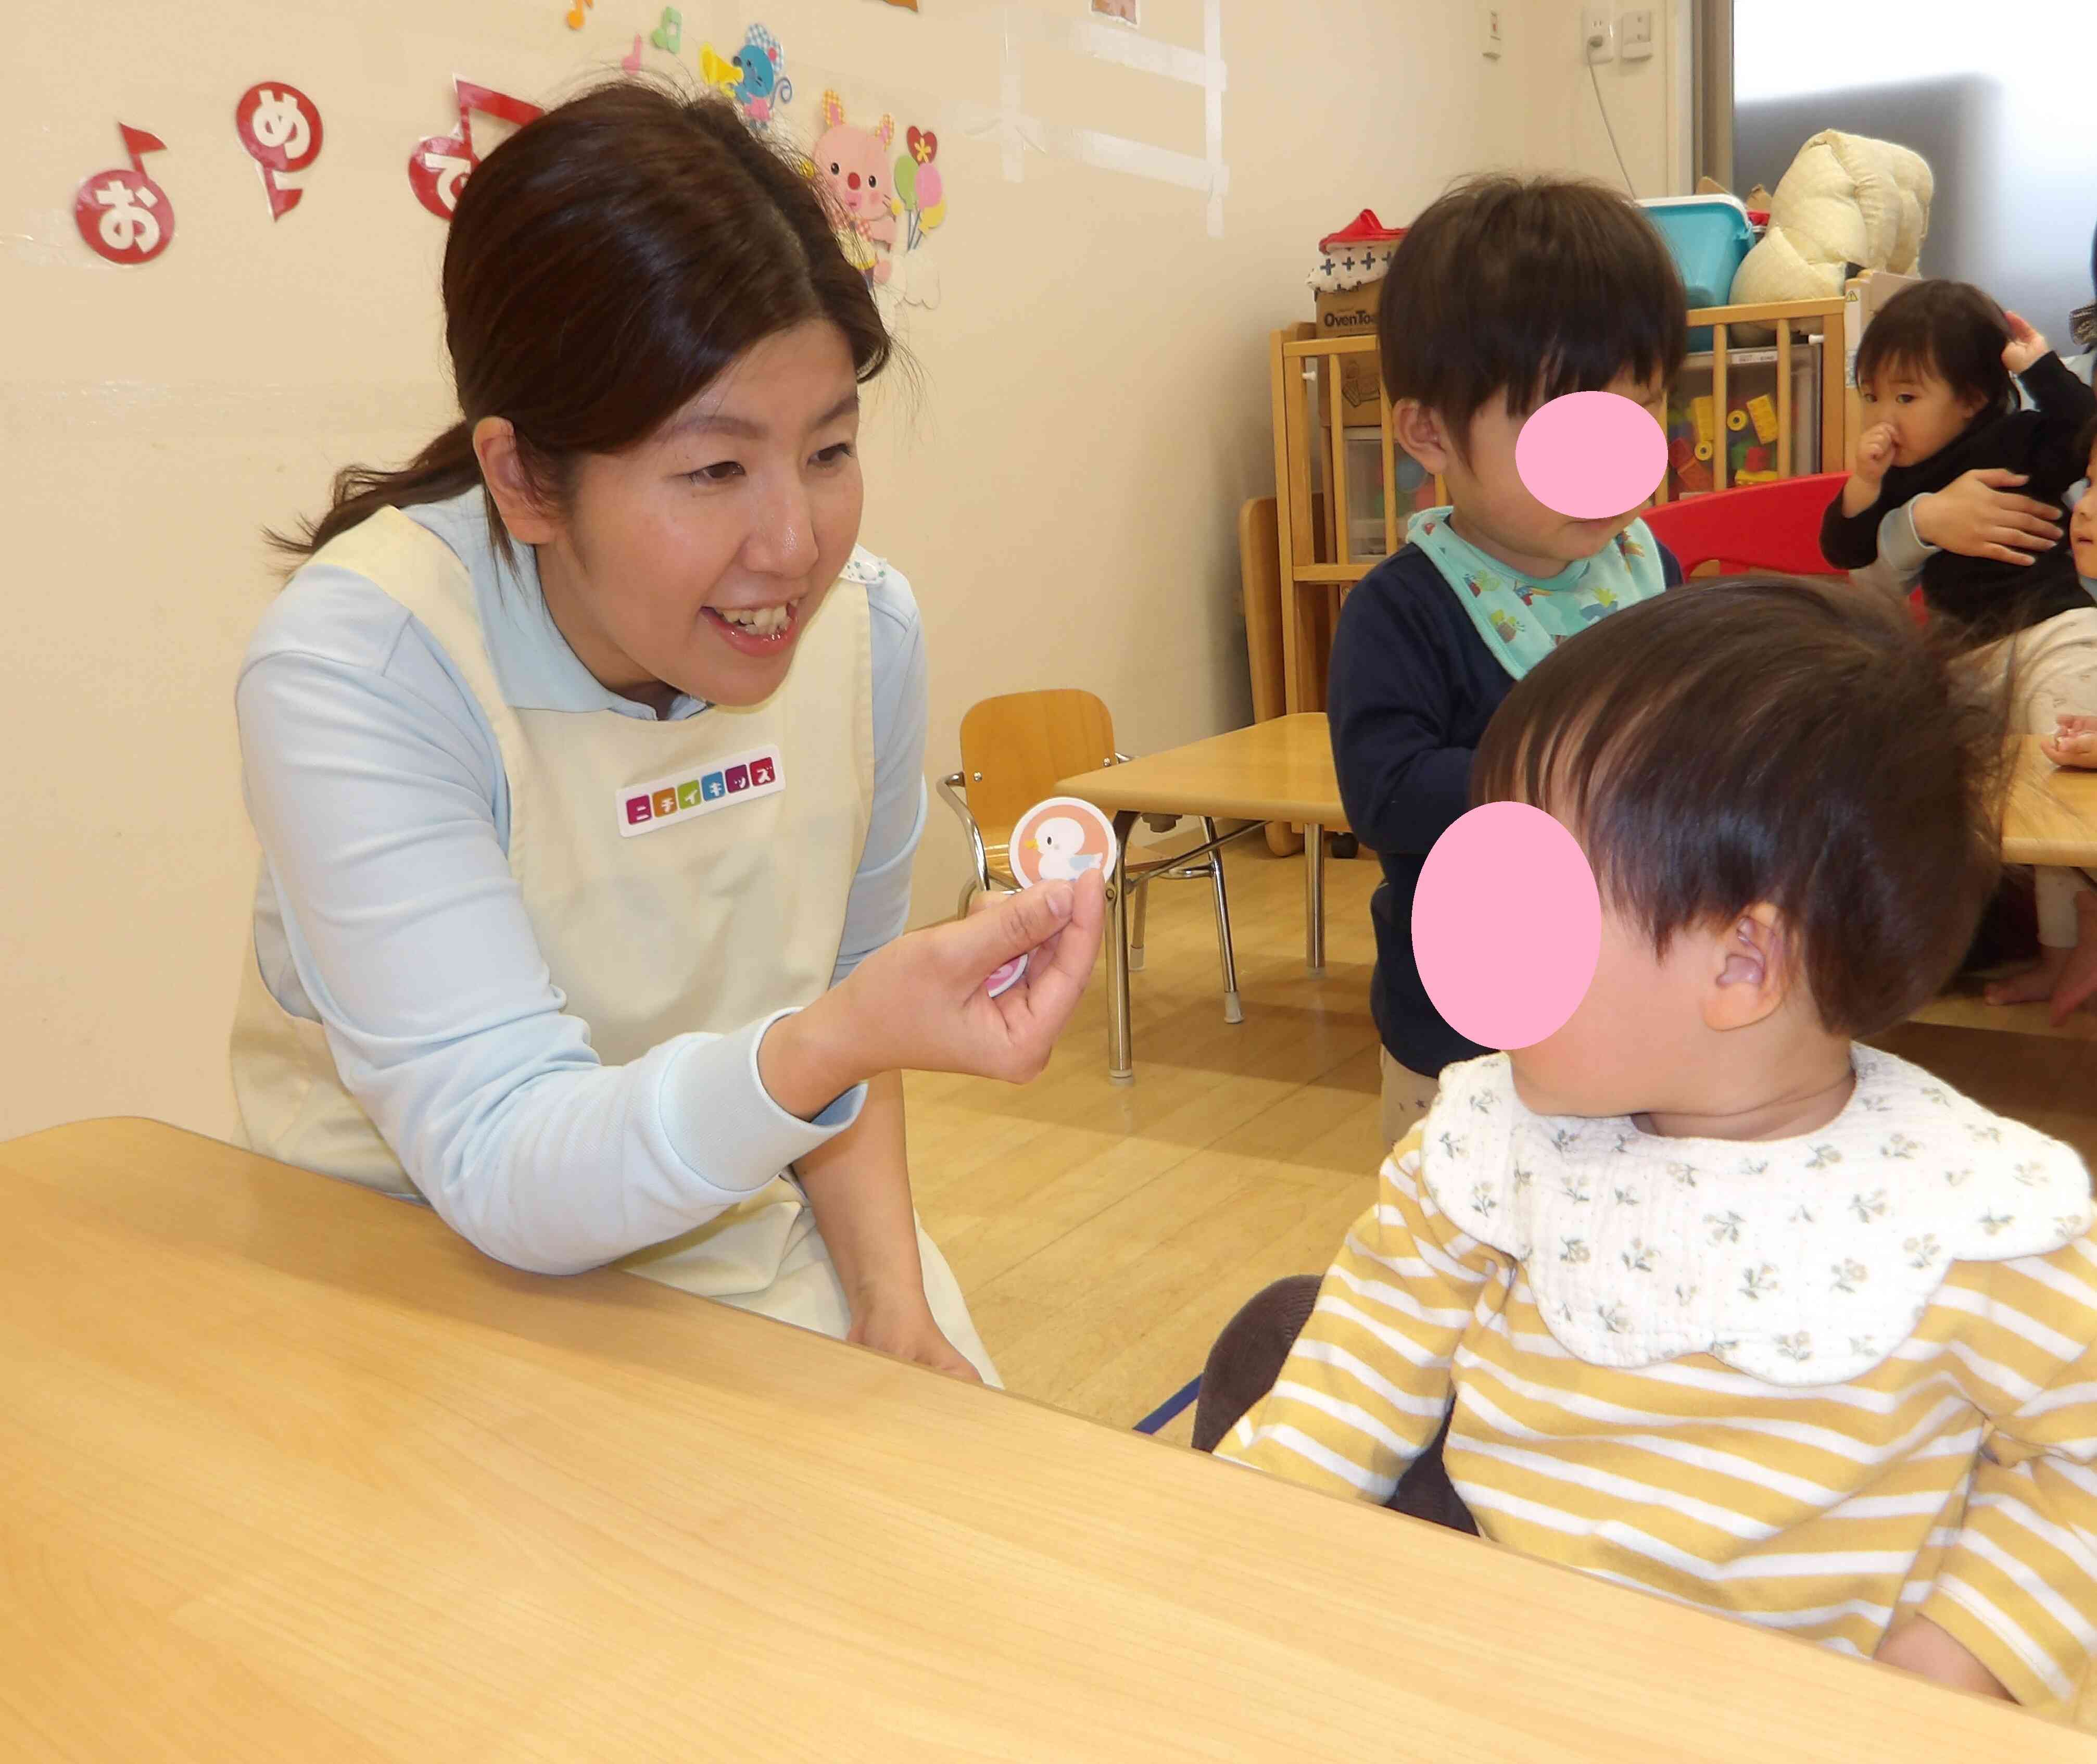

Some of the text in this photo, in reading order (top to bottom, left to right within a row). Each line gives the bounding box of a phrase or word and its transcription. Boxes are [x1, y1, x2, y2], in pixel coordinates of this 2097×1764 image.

[96, 180, 160, 254] お
[252, 89, 311, 160] め
[1324, 310, 1374, 327] OvenTo
[636, 765, 773, 821] ニチイキッズ
